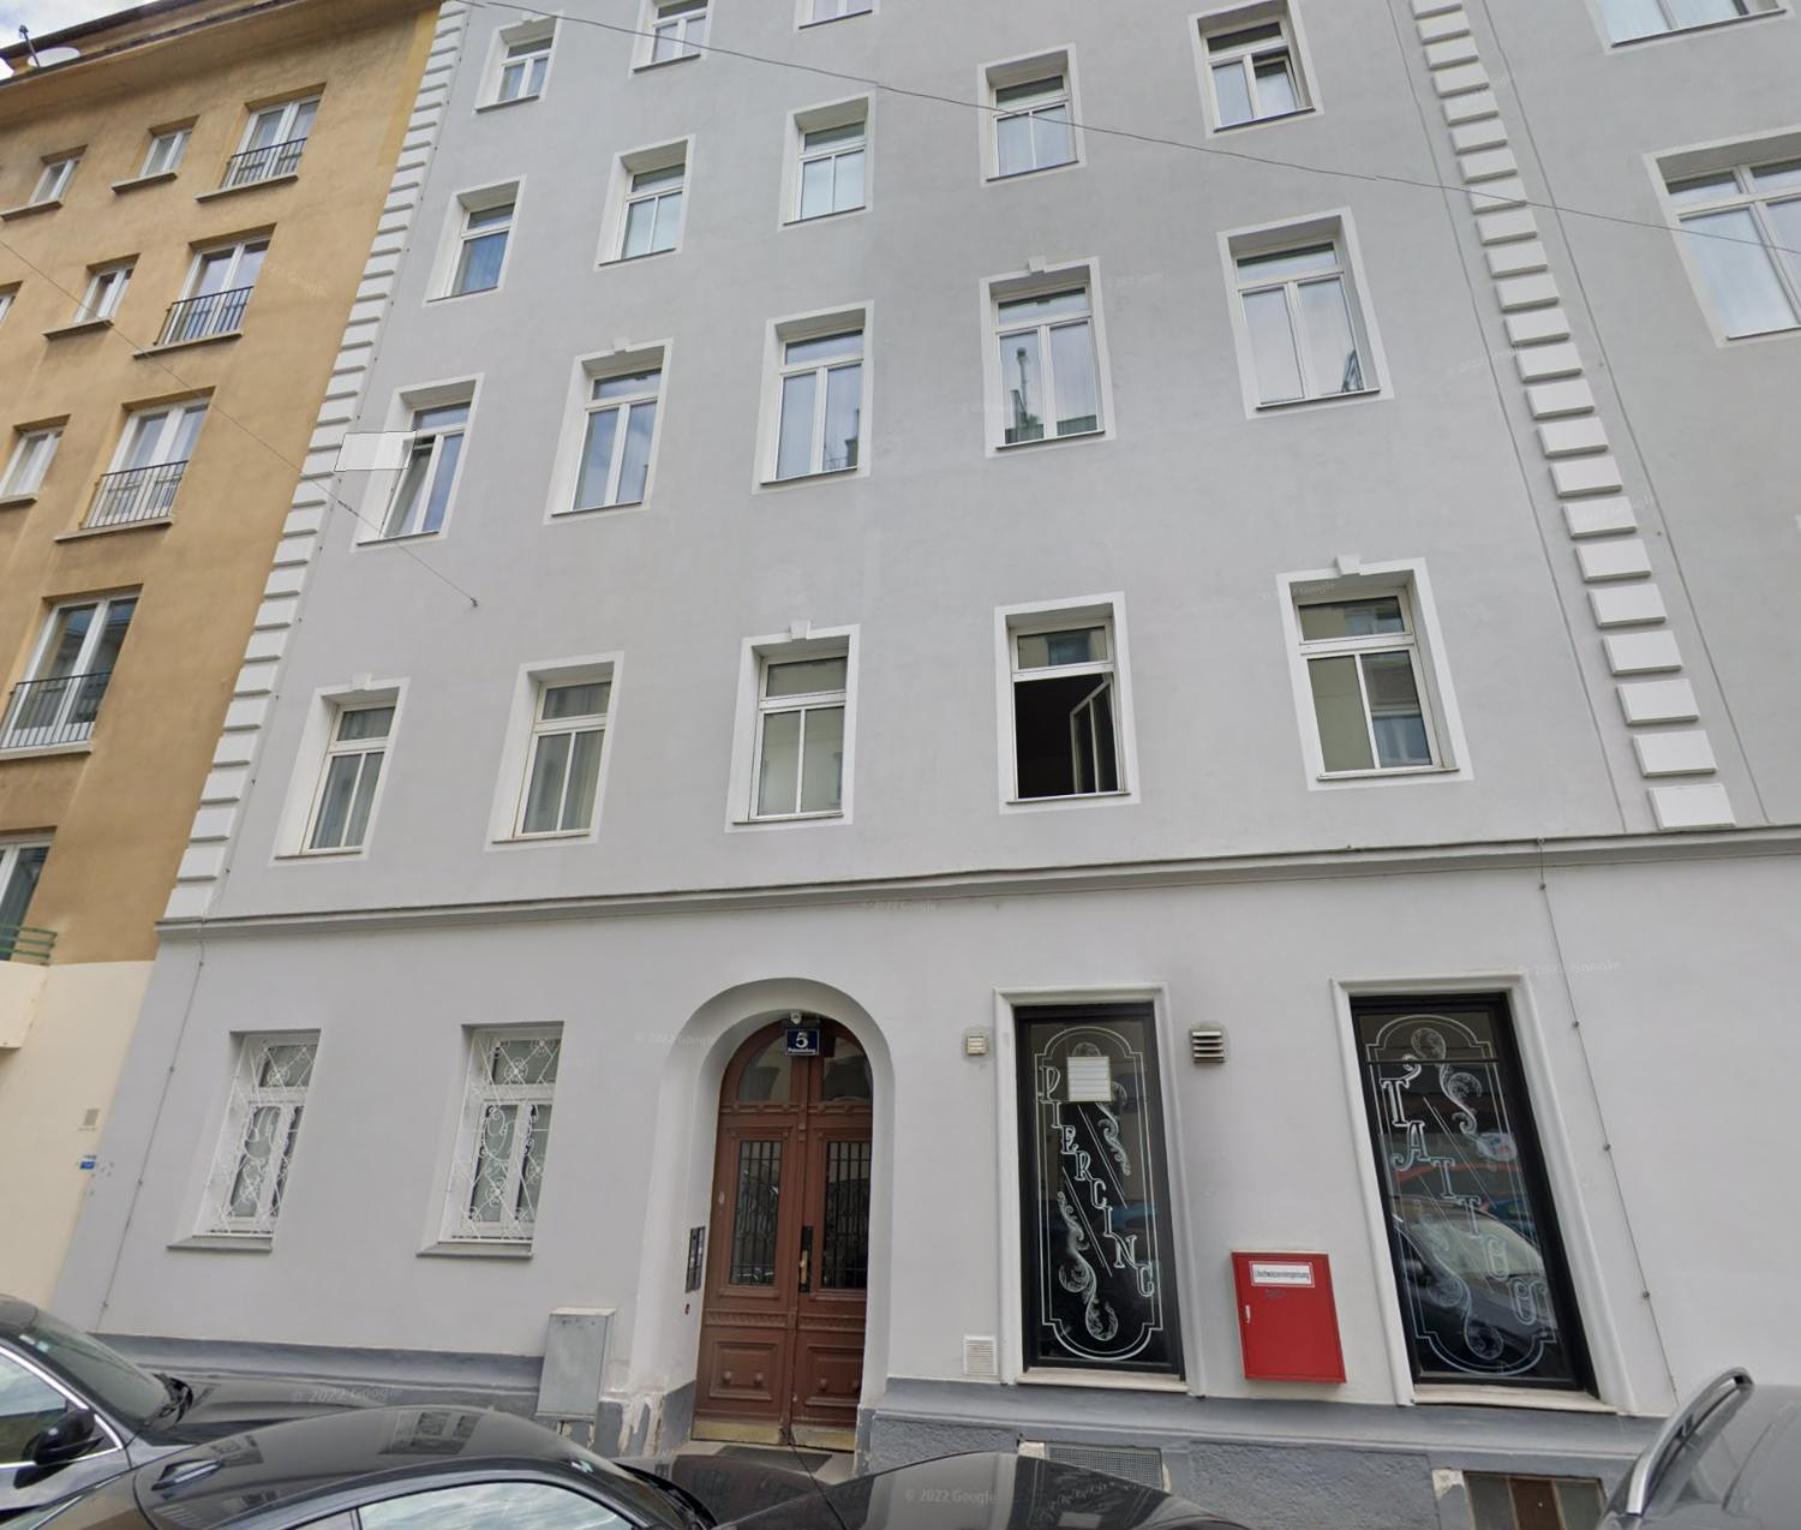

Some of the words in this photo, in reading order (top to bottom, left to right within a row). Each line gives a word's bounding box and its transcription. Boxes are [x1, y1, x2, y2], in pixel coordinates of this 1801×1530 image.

[795, 1031, 809, 1048] 5
[1037, 1064, 1155, 1297] PIERCING
[1380, 1060, 1547, 1325] TATTOO
